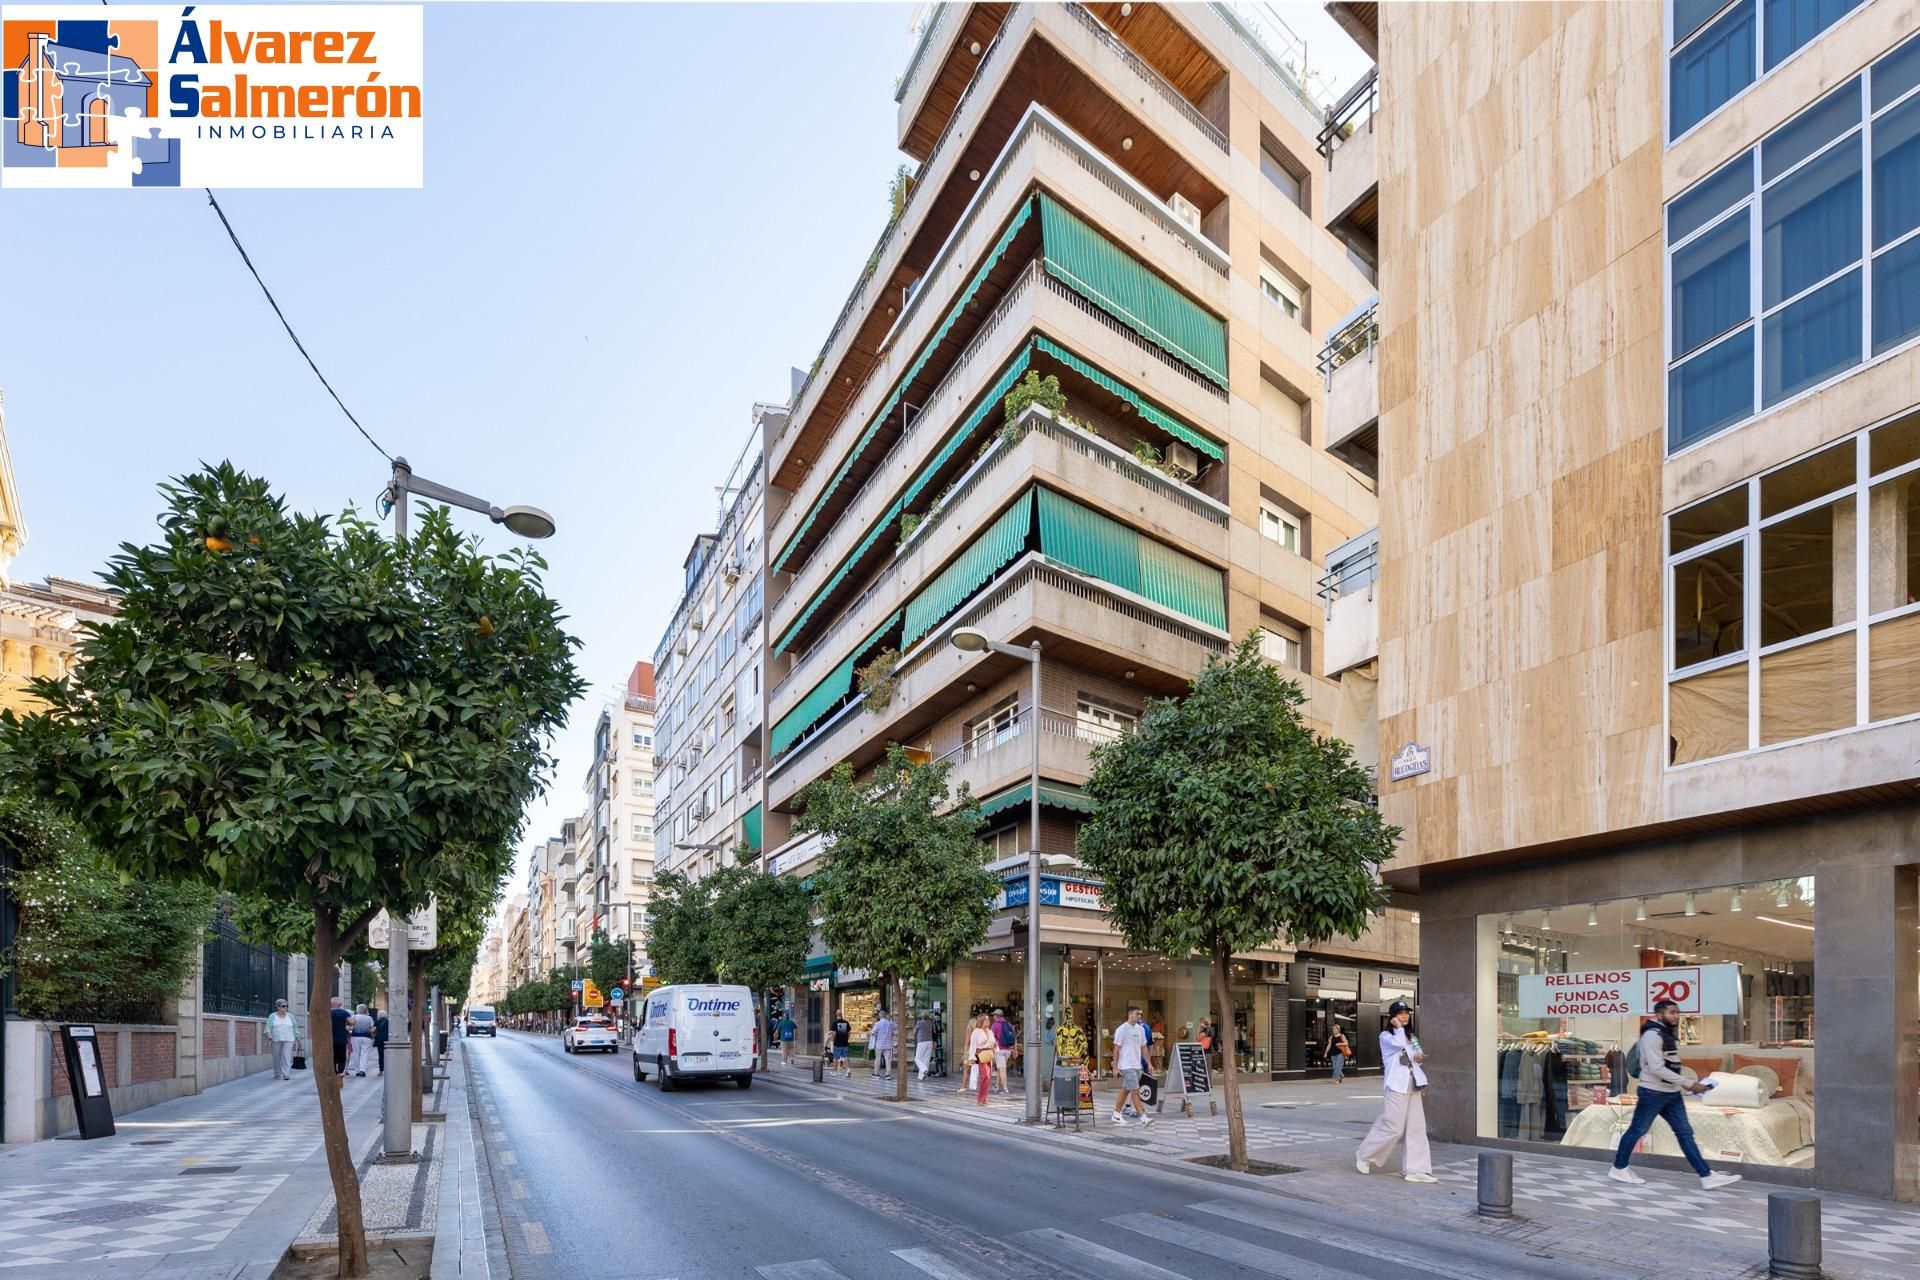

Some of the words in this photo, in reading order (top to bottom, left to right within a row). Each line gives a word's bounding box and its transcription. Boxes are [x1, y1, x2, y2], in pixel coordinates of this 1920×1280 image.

[1545, 971, 1631, 986] RELLENOS
[1555, 989, 1620, 1002] FUNDAS
[687, 998, 740, 1011] Ontime
[1546, 1001, 1629, 1015] NÓRDICAS
